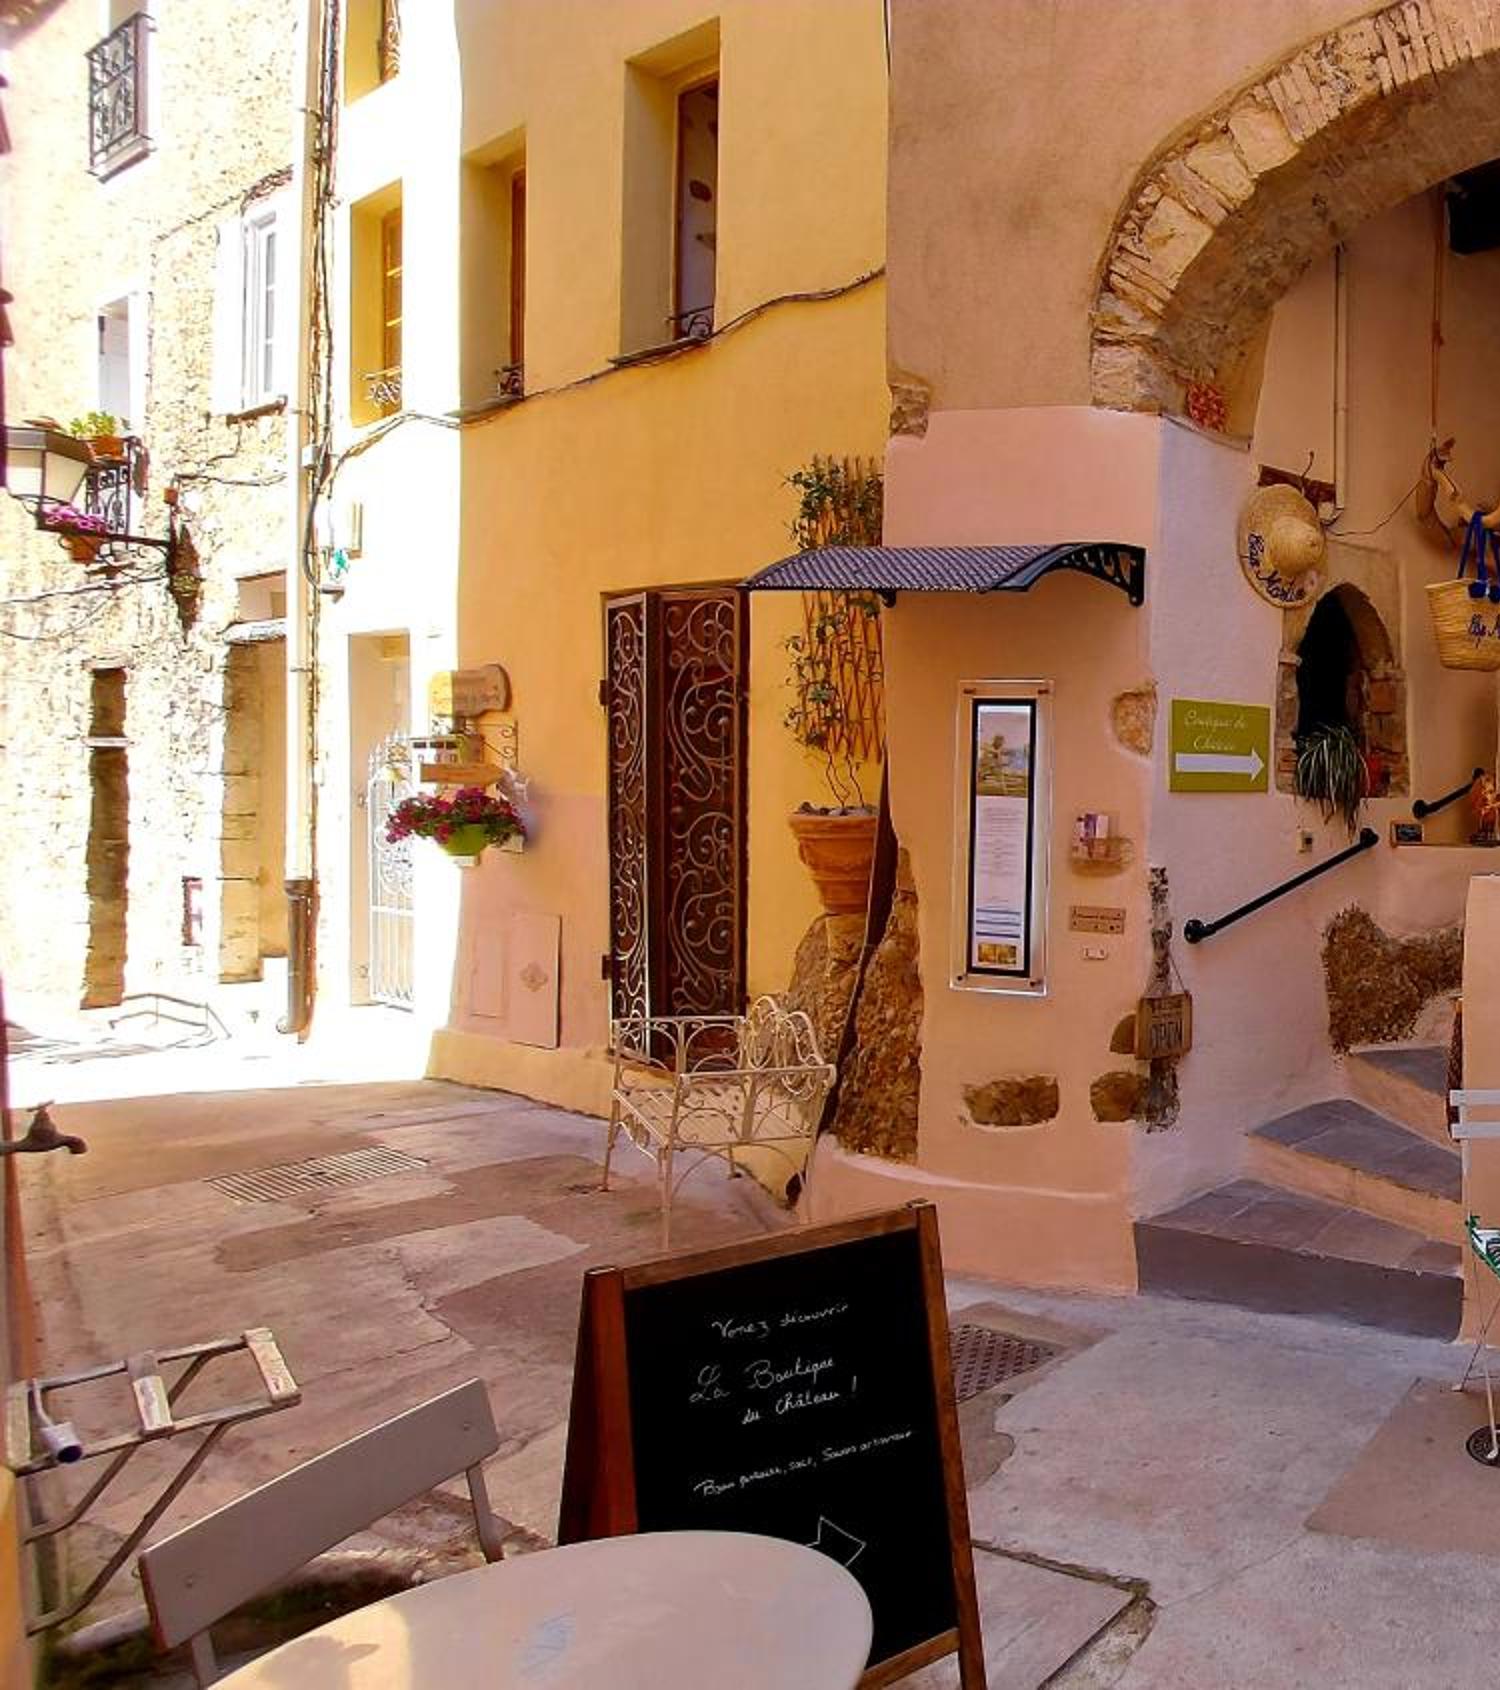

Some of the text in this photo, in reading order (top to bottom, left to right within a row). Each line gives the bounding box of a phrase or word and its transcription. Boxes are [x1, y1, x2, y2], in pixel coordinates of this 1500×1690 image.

[689, 1357, 836, 1403] La Boutique
[741, 1408, 763, 1425] du
